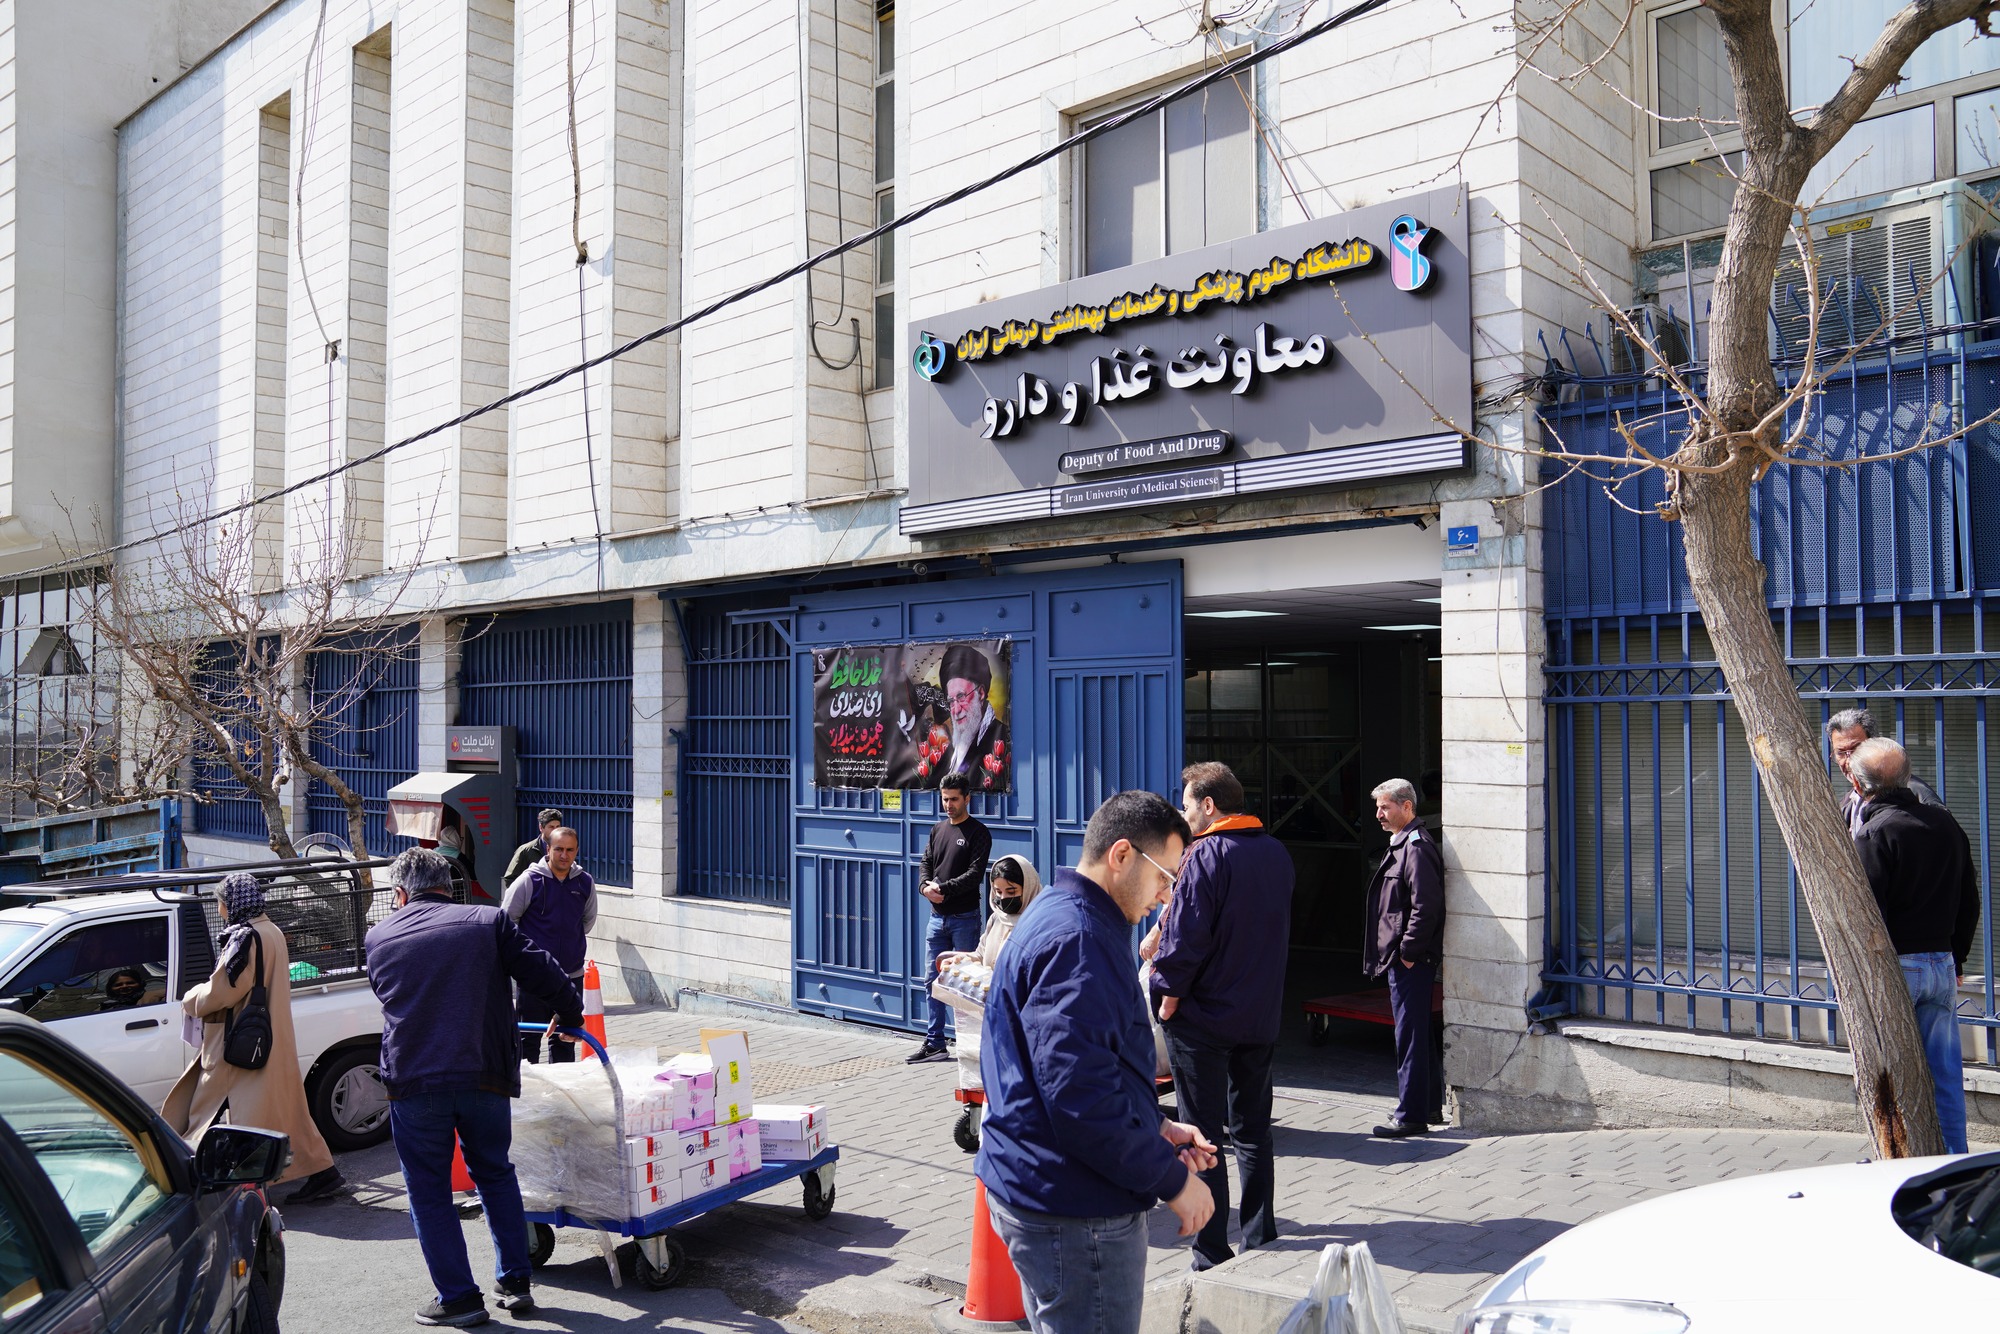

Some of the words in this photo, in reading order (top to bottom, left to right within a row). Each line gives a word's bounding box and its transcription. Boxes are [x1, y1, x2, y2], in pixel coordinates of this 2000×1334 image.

[1247, 258, 1293, 301] علوم
[1296, 240, 1374, 281] دانشگاه
[1108, 284, 1167, 322] خدمات
[1165, 290, 1180, 315] و
[1181, 272, 1244, 311] پزشکی
[991, 318, 1039, 355] درمانی
[1042, 303, 1106, 344] بهداشتی
[956, 326, 990, 361] ایران
[1166, 321, 1328, 396] معاونت
[1090, 345, 1153, 406] غذا
[979, 372, 1052, 440] دارو
[1058, 381, 1082, 426] و
[1064, 452, 1104, 470] Deputy
[1106, 447, 1120, 463] of
[1124, 443, 1154, 460] Food
[1158, 438, 1184, 455] And
[1187, 436, 1221, 451] Drug
[1065, 493, 1084, 504] Iran
[1085, 486, 1129, 502] University
[1130, 484, 1141, 495] of
[1141, 479, 1178, 494] Medical
[1179, 476, 1219, 489] Sciencse
[461, 734, 477, 746] ملت
